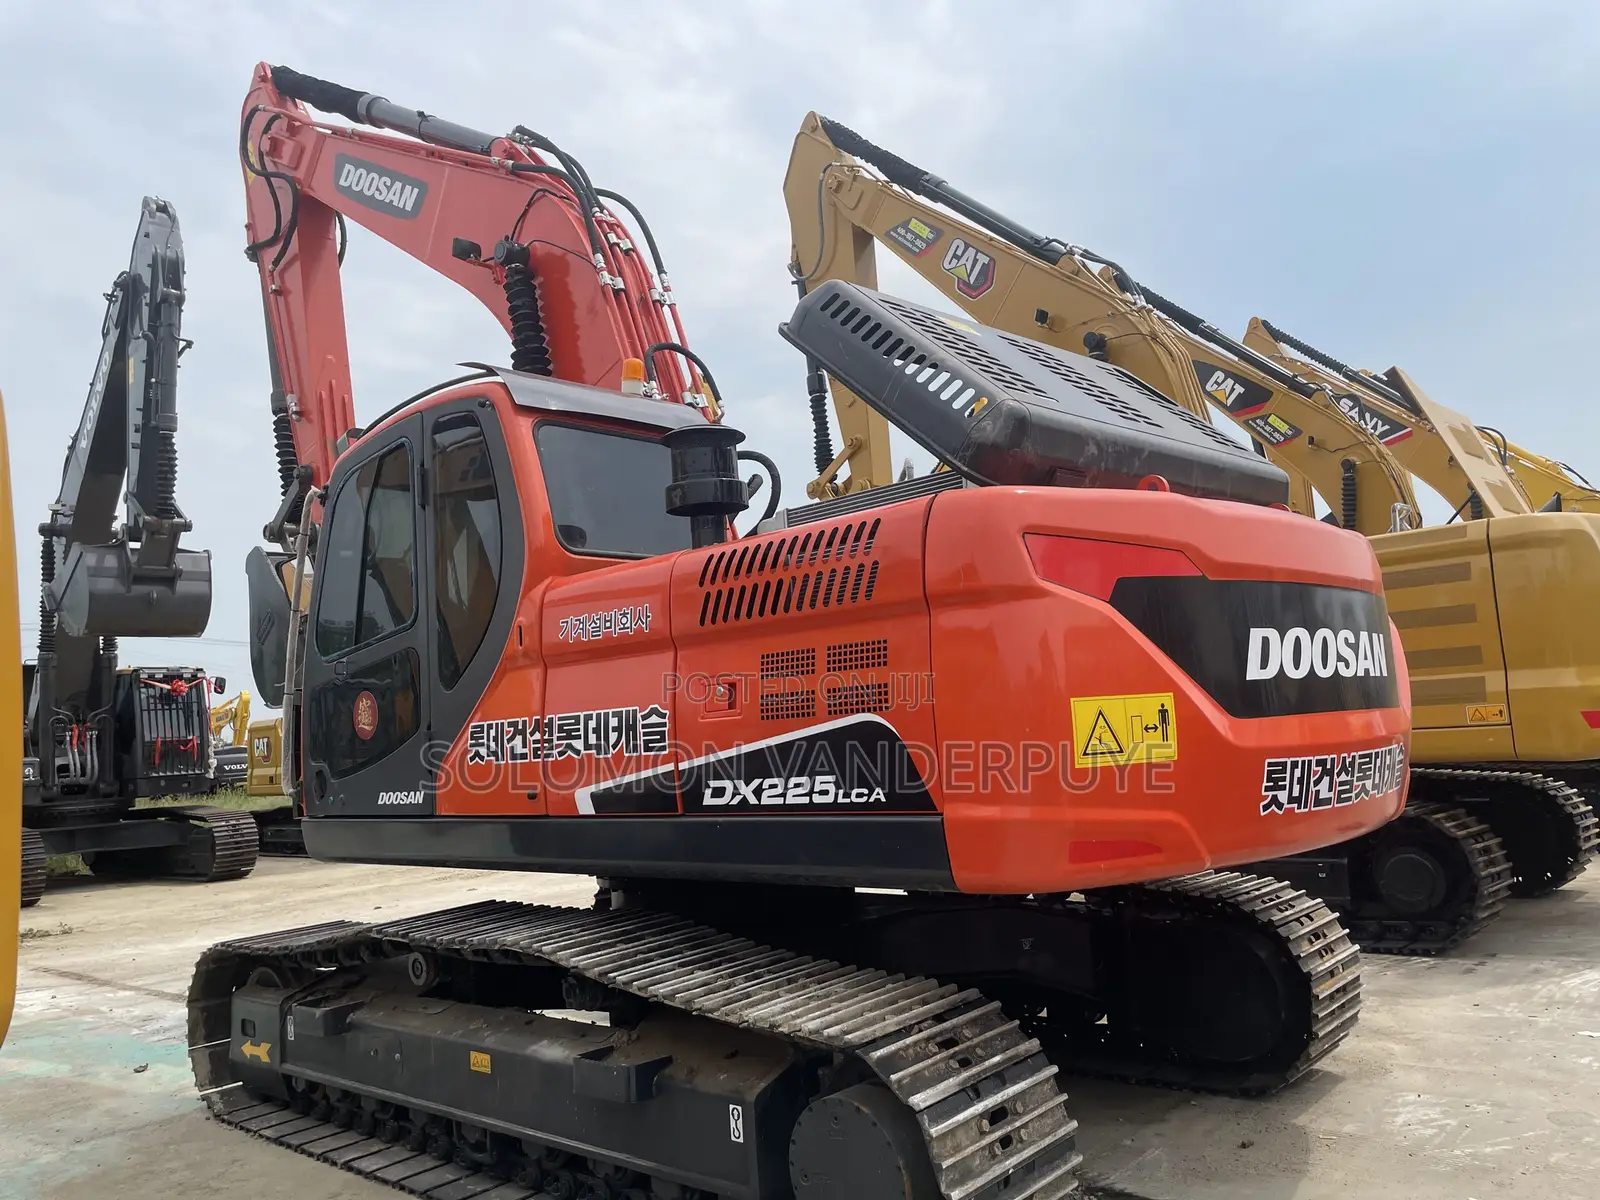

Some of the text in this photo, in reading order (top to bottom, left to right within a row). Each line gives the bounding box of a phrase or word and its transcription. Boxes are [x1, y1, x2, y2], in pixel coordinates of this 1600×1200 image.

[338, 163, 420, 212] DOOSAN
[943, 239, 991, 285] CAT
[81, 351, 110, 449] VOLVO
[1206, 370, 1246, 407] CAT
[559, 603, 652, 643] 기계설비회사
[1245, 627, 1388, 681] DOOSAN
[254, 738, 269, 757] CAT
[377, 791, 425, 805] DOOSAN
